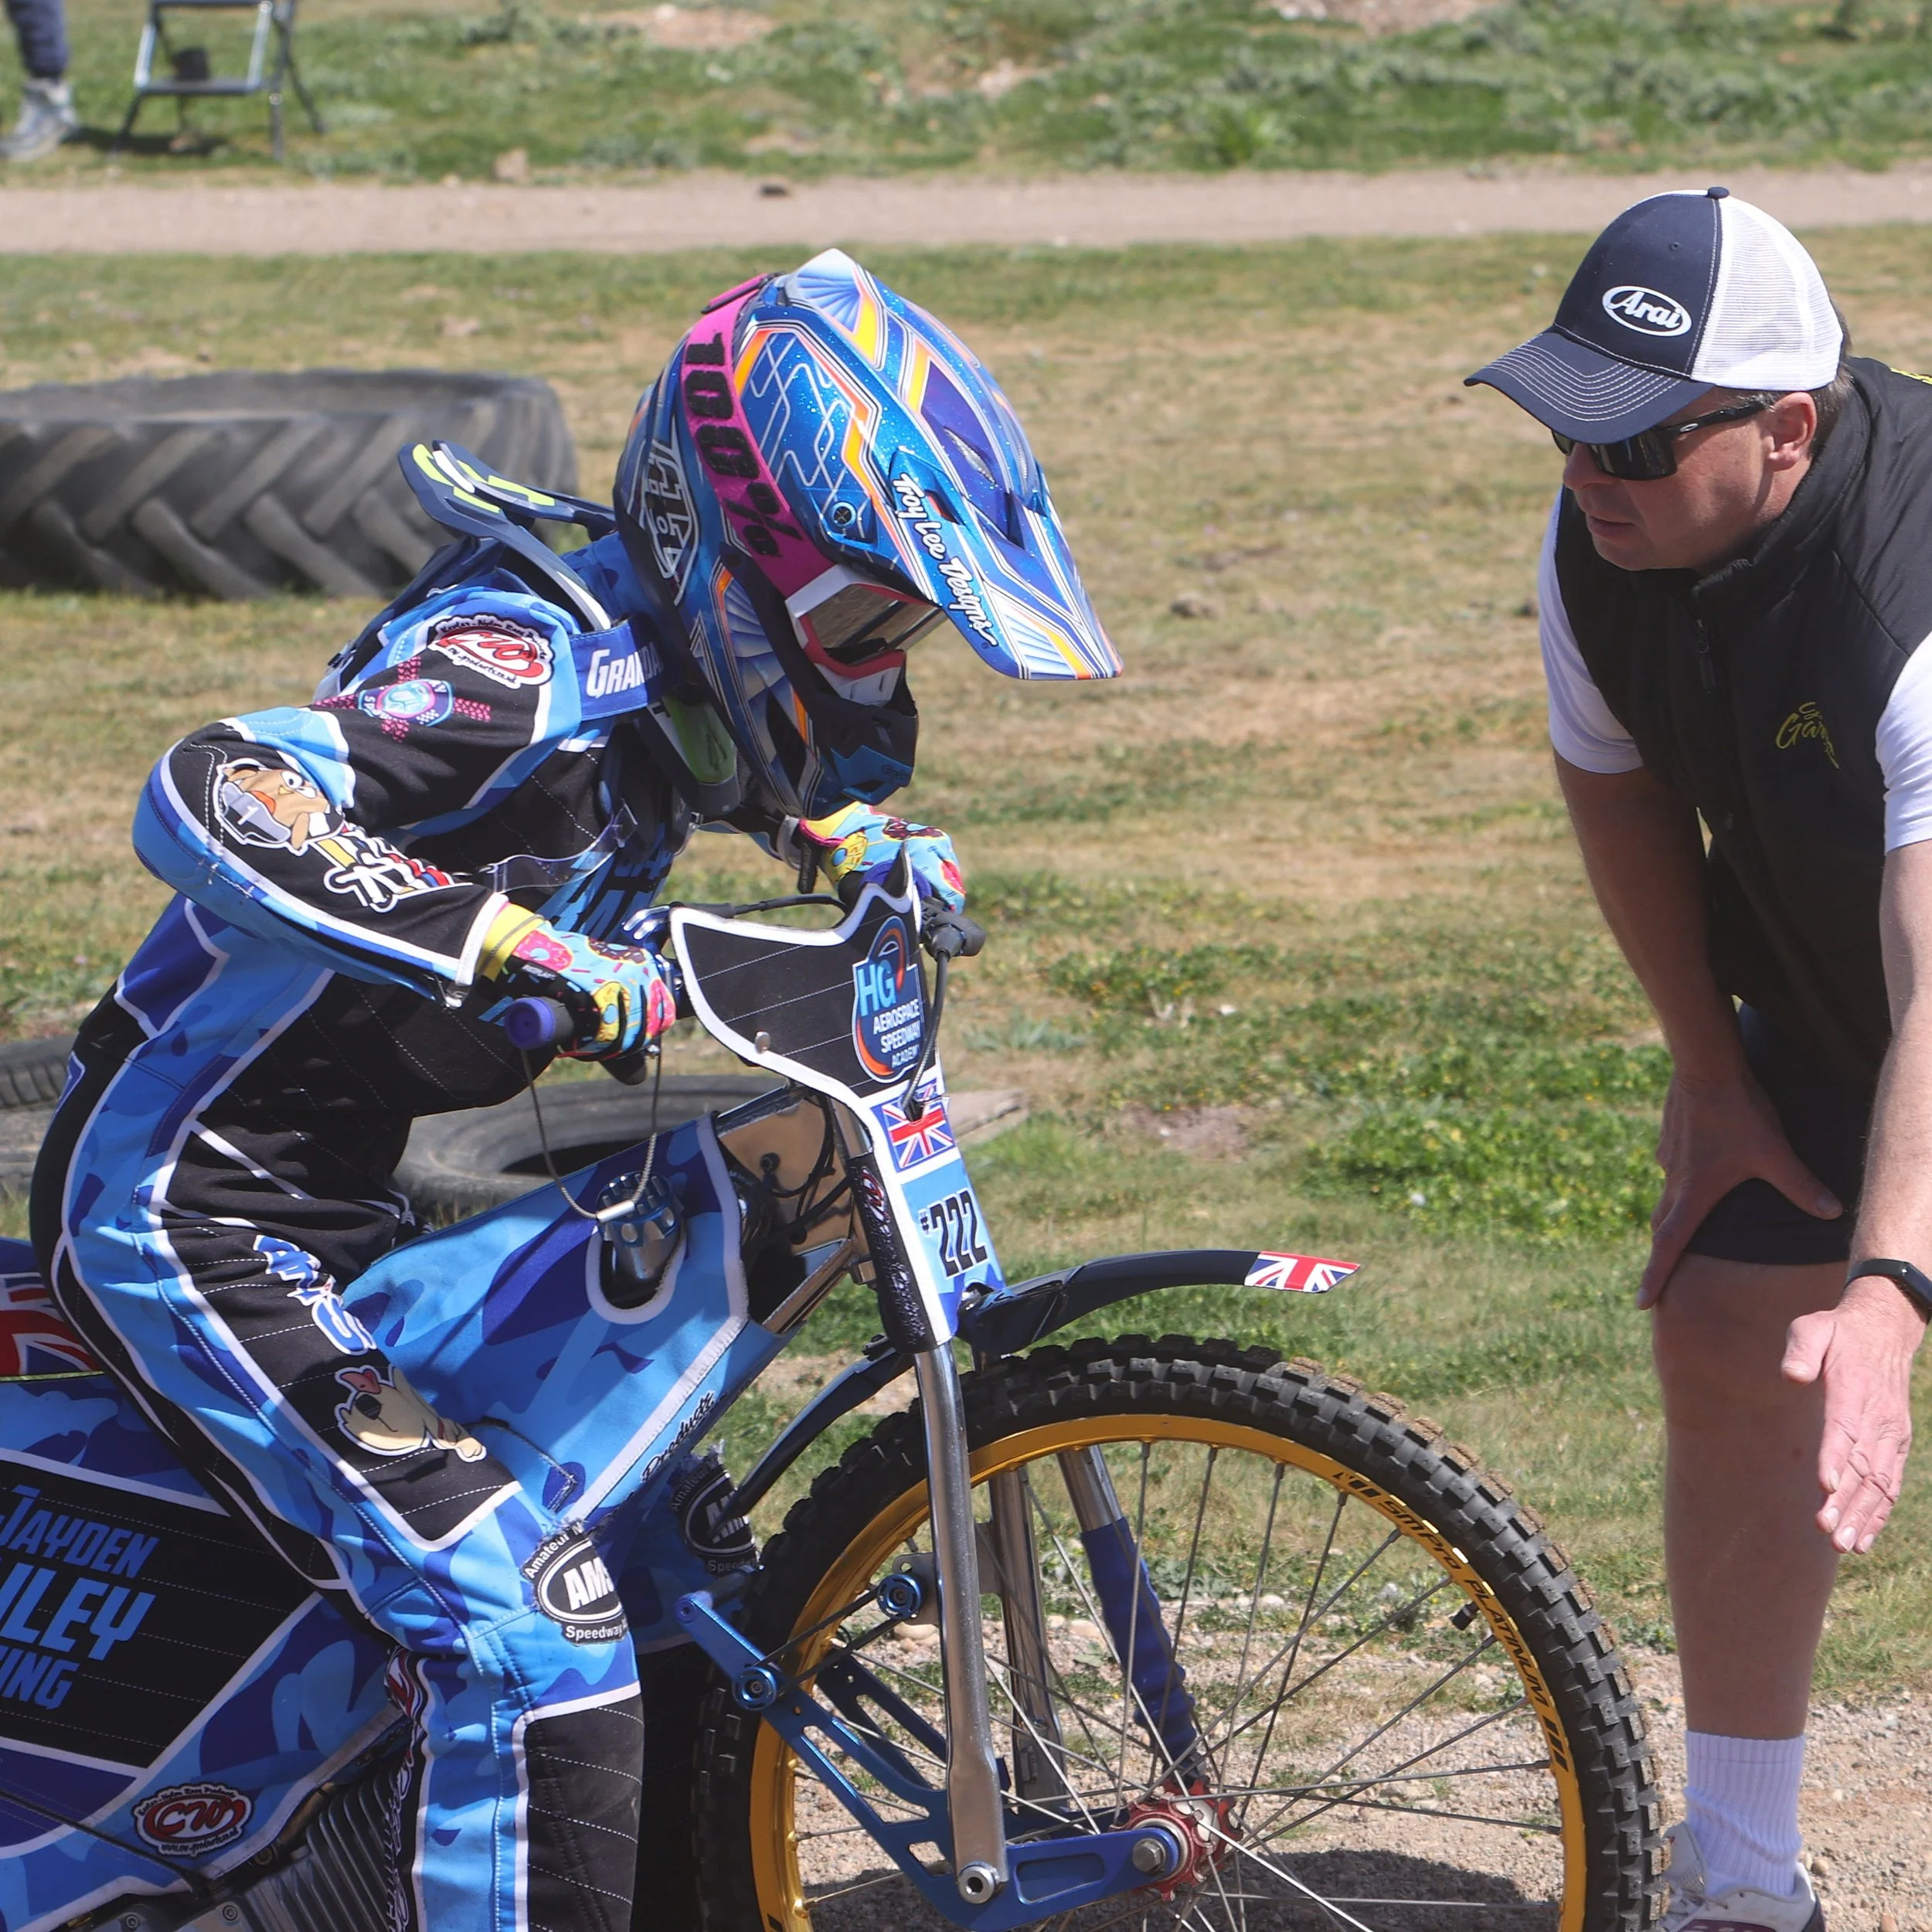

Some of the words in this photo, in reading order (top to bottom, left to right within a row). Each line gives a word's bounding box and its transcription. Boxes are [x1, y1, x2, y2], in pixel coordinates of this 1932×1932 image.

[1608, 291, 1682, 328] Arai
[685, 332, 804, 558] 100%
[893, 472, 928, 519] Troy
[914, 521, 947, 560] Lee
[938, 556, 998, 647] Designs
[857, 959, 897, 1018] HG
[873, 998, 921, 1036] AEROSPACE
[880, 1020, 922, 1054] SPEEDWAY
[0, 1485, 160, 1579] JAYDEN
[524, 1532, 571, 1580] Amateur
[0, 1557, 157, 1661] ILEY
[566, 1623, 623, 1641] Speedway
[1464, 1579, 1550, 1708] PLATINUM
[0, 1645, 80, 1710] ING
